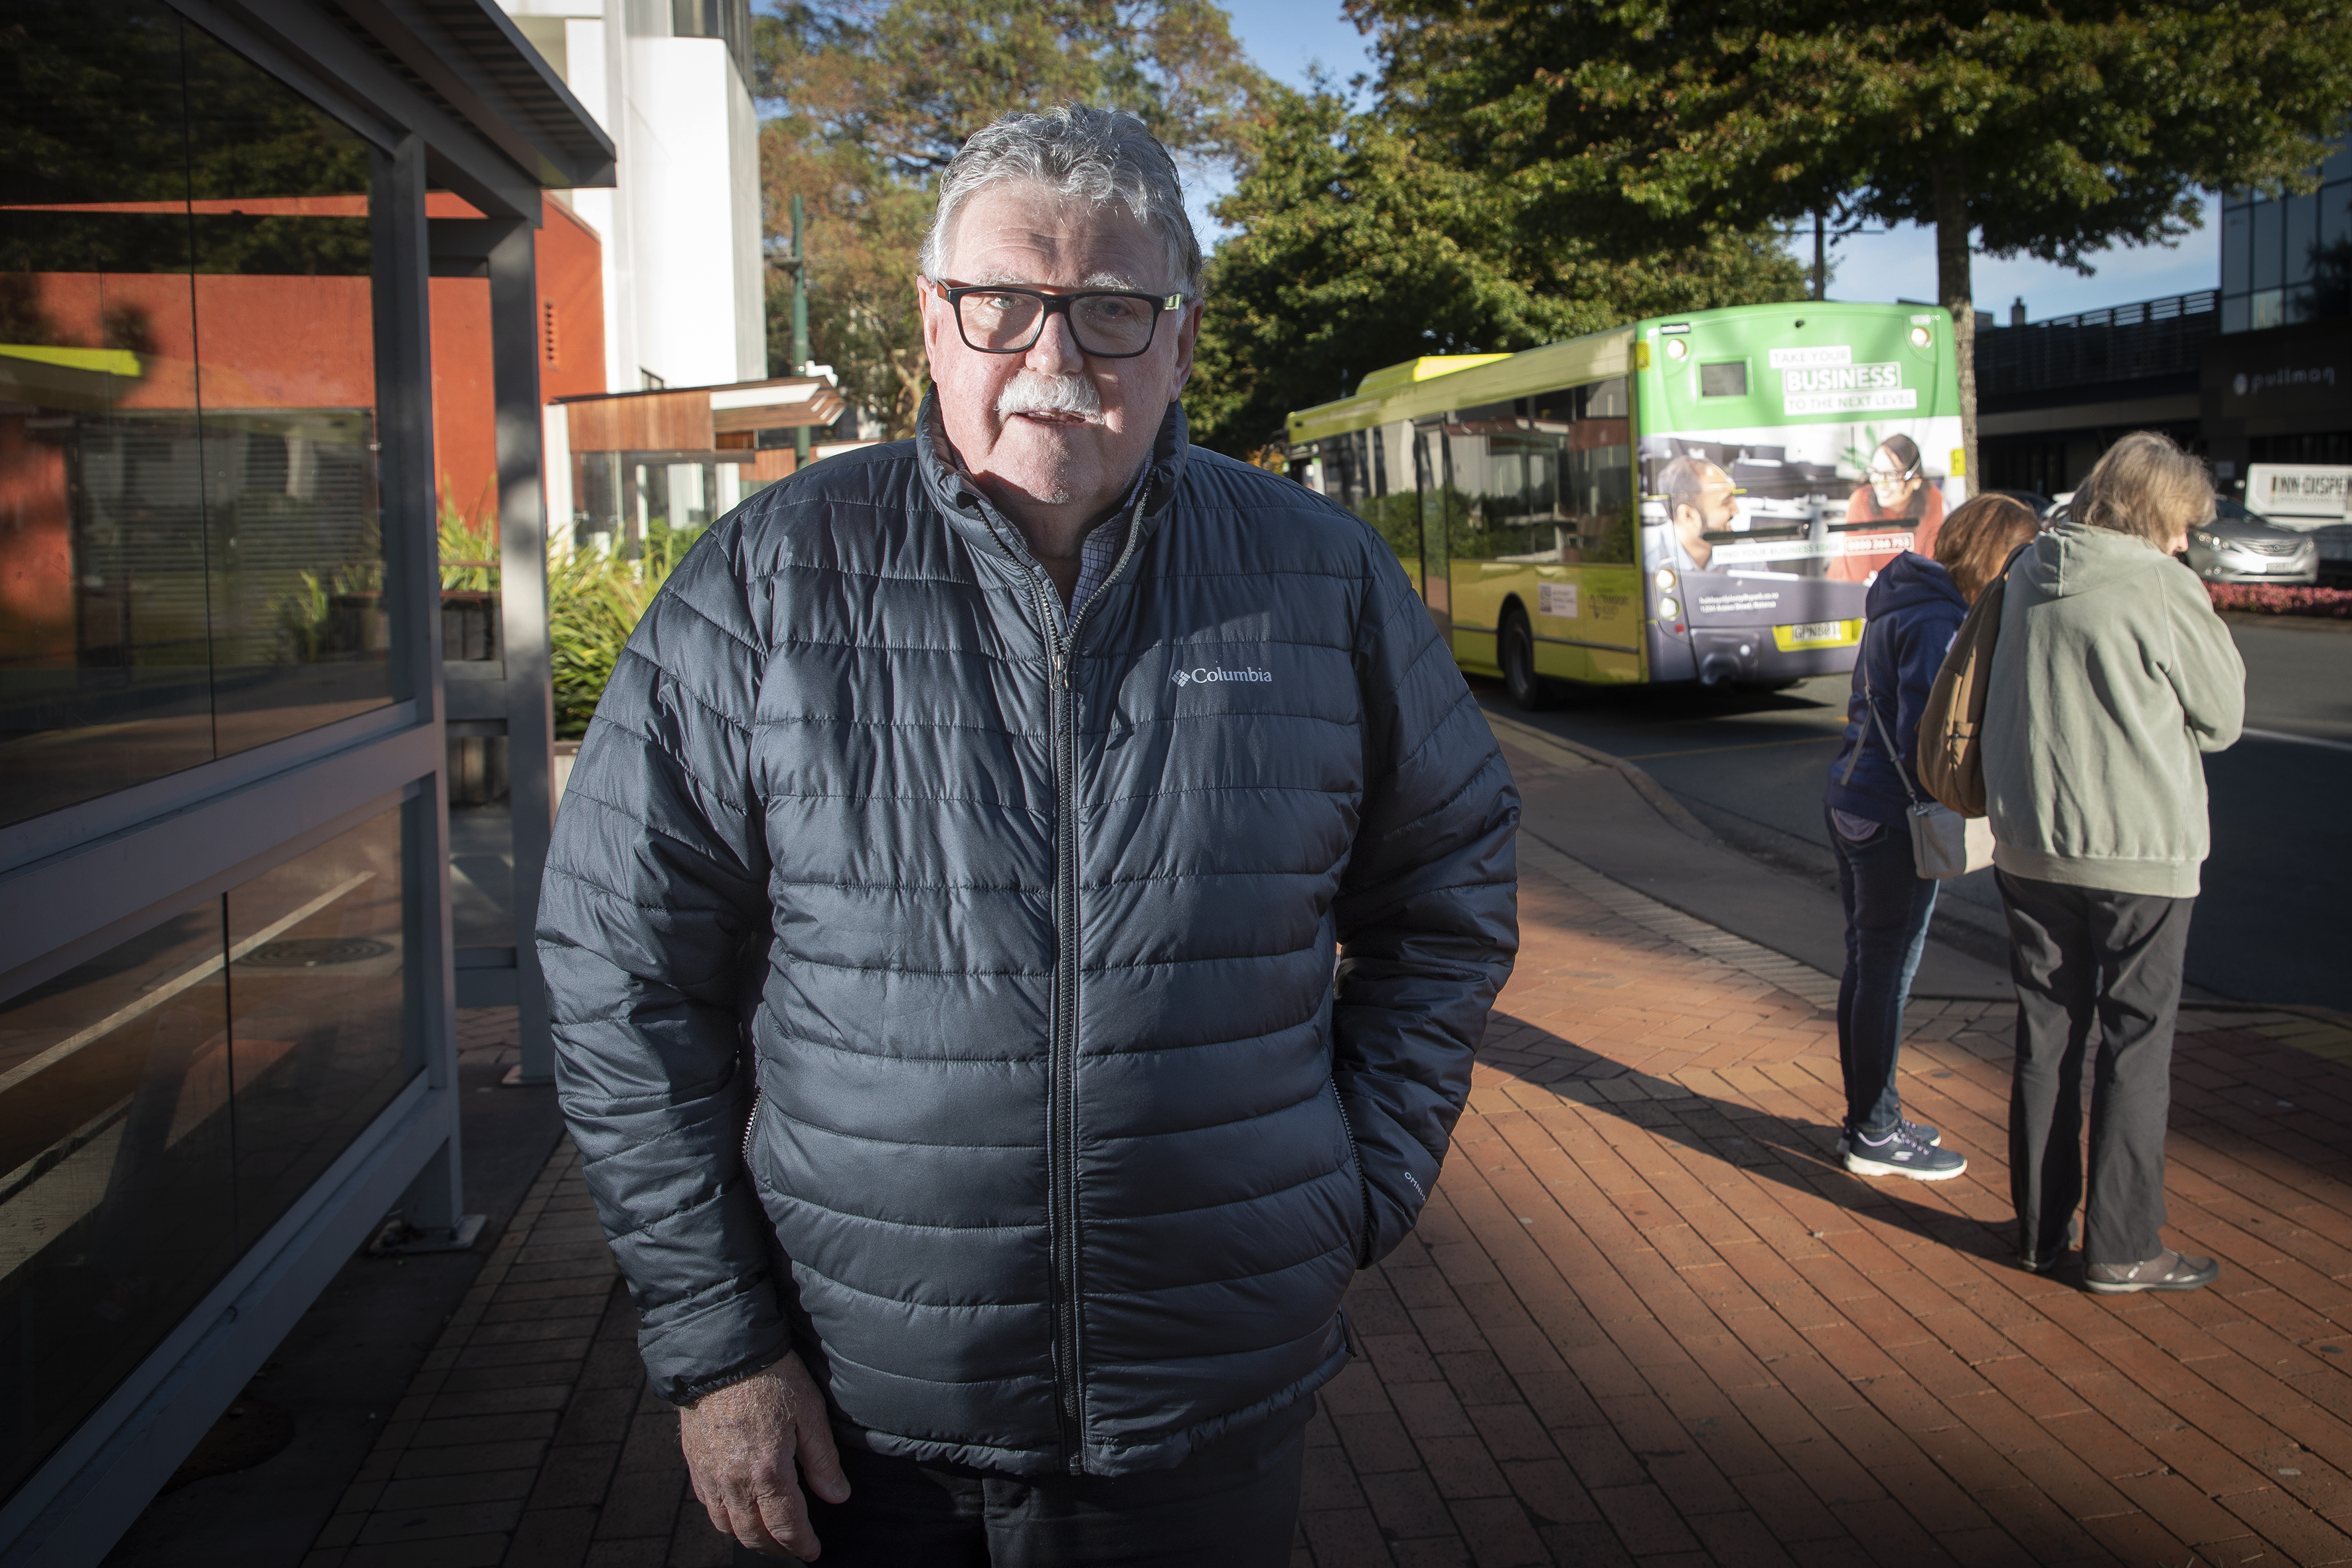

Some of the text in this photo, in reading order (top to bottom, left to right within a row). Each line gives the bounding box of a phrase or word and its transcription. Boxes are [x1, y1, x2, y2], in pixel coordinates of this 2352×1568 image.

[1773, 349, 1848, 364] TAKE YOUR
[1786, 366, 1897, 392] BUSINESS
[2251, 364, 2335, 396] pullman
[1788, 392, 1912, 410] TO THE NEXT LEVEL
[1717, 550, 1739, 559] FIND
[1770, 544, 1813, 555] BUSINESS
[1816, 542, 1838, 552] EDGE
[1191, 666, 1272, 684] Columbia
